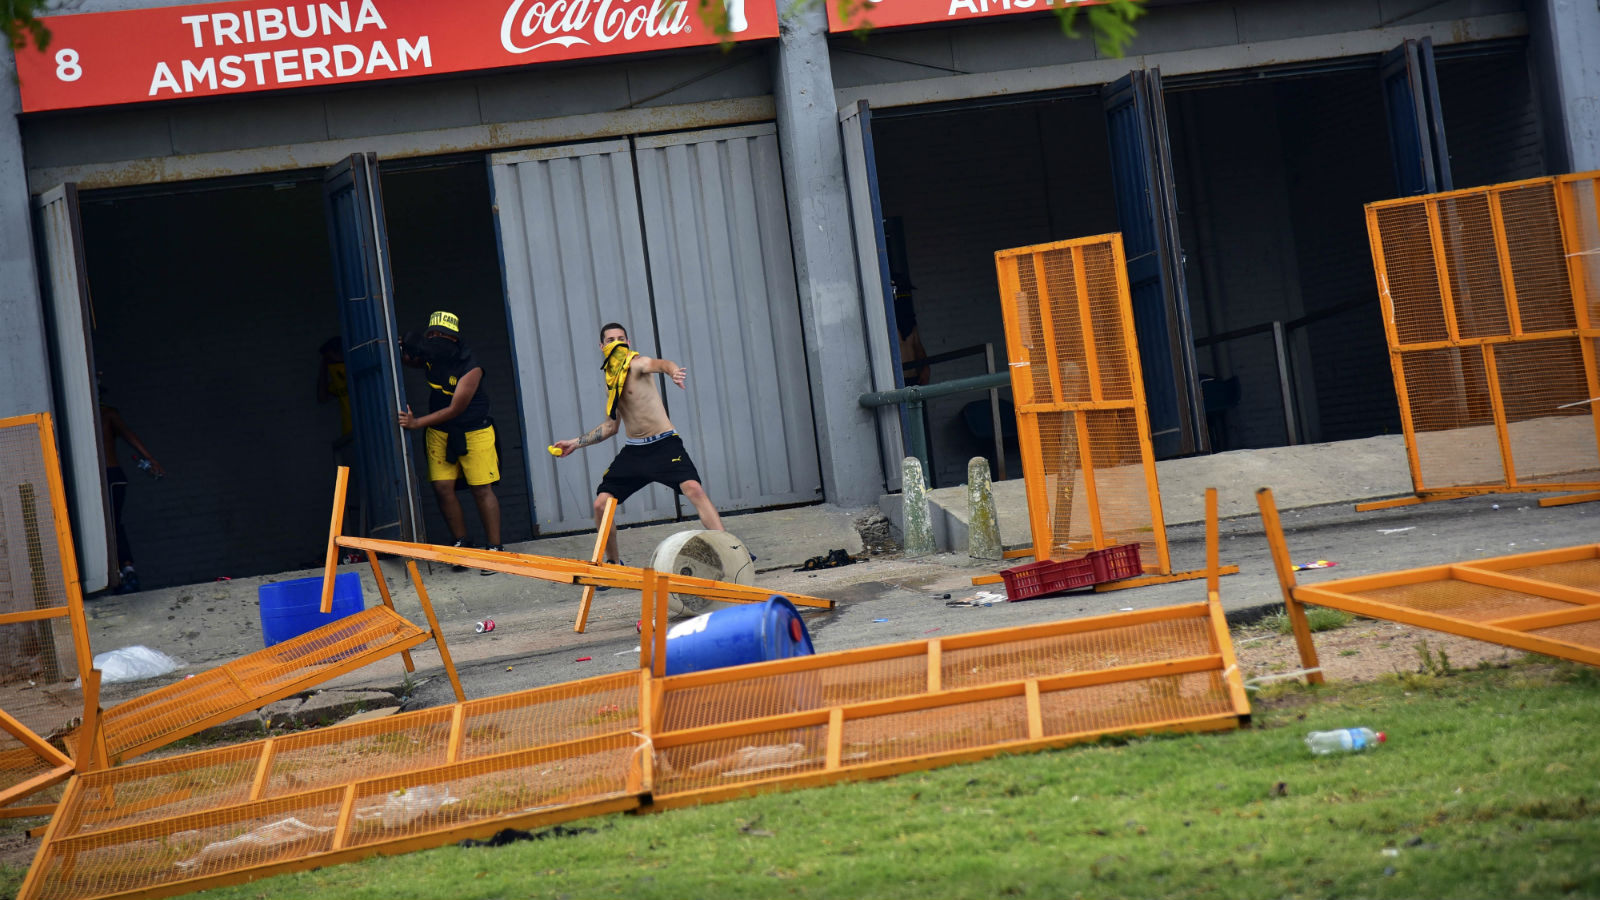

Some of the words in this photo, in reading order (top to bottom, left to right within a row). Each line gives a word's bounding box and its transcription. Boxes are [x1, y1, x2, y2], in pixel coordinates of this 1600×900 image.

[181, 0, 388, 48] TRIBUNA
[500, 0, 689, 54] Coca-Cola
[55, 48, 83, 82] 8
[148, 35, 433, 96] AMSTERDAM
